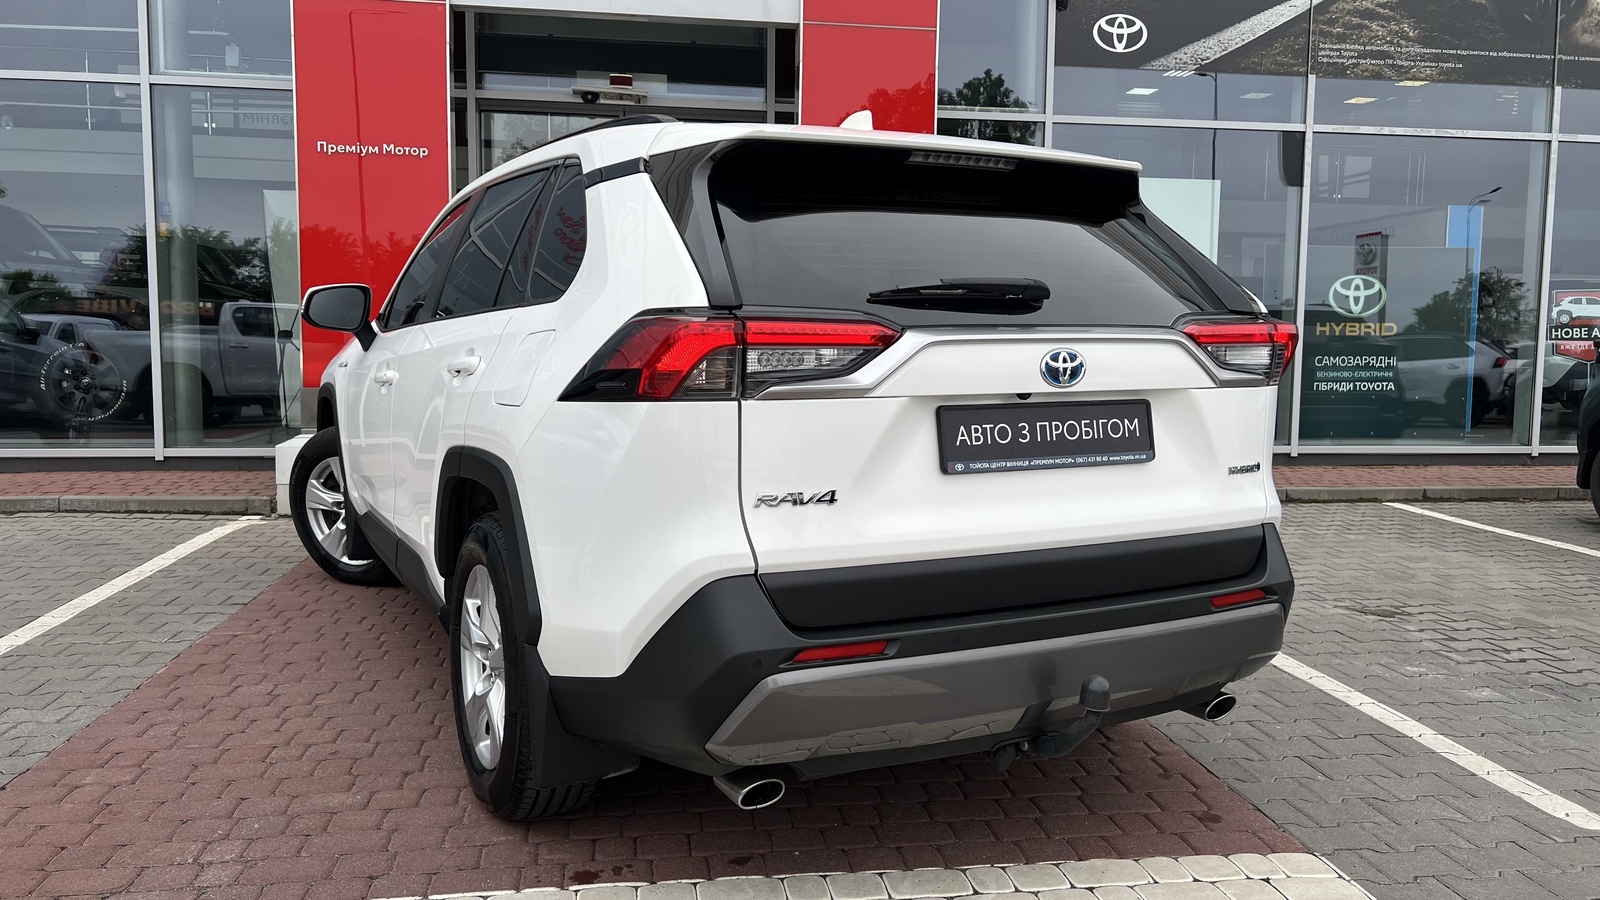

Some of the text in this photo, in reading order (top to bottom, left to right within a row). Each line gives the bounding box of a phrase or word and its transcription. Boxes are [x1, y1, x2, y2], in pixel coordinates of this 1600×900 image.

[243, 113, 293, 126] МІНЯЄ
[317, 141, 429, 158] Преміум Мотор
[1316, 322, 1398, 336] HYBRID
[1552, 328, 1588, 338] НОВЕ
[1314, 356, 1396, 368] САМОЗАРЯДНІ
[1314, 382, 1395, 392] ГІБРИДИ TOYOTA
[956, 424, 1012, 446] АВТО
[1036, 418, 1140, 442] ПРОБІГОМ
[1006, 460, 1029, 468] ВІННИЦЯ
[1228, 462, 1260, 476] HYBRID
[754, 490, 838, 508] RAV4
